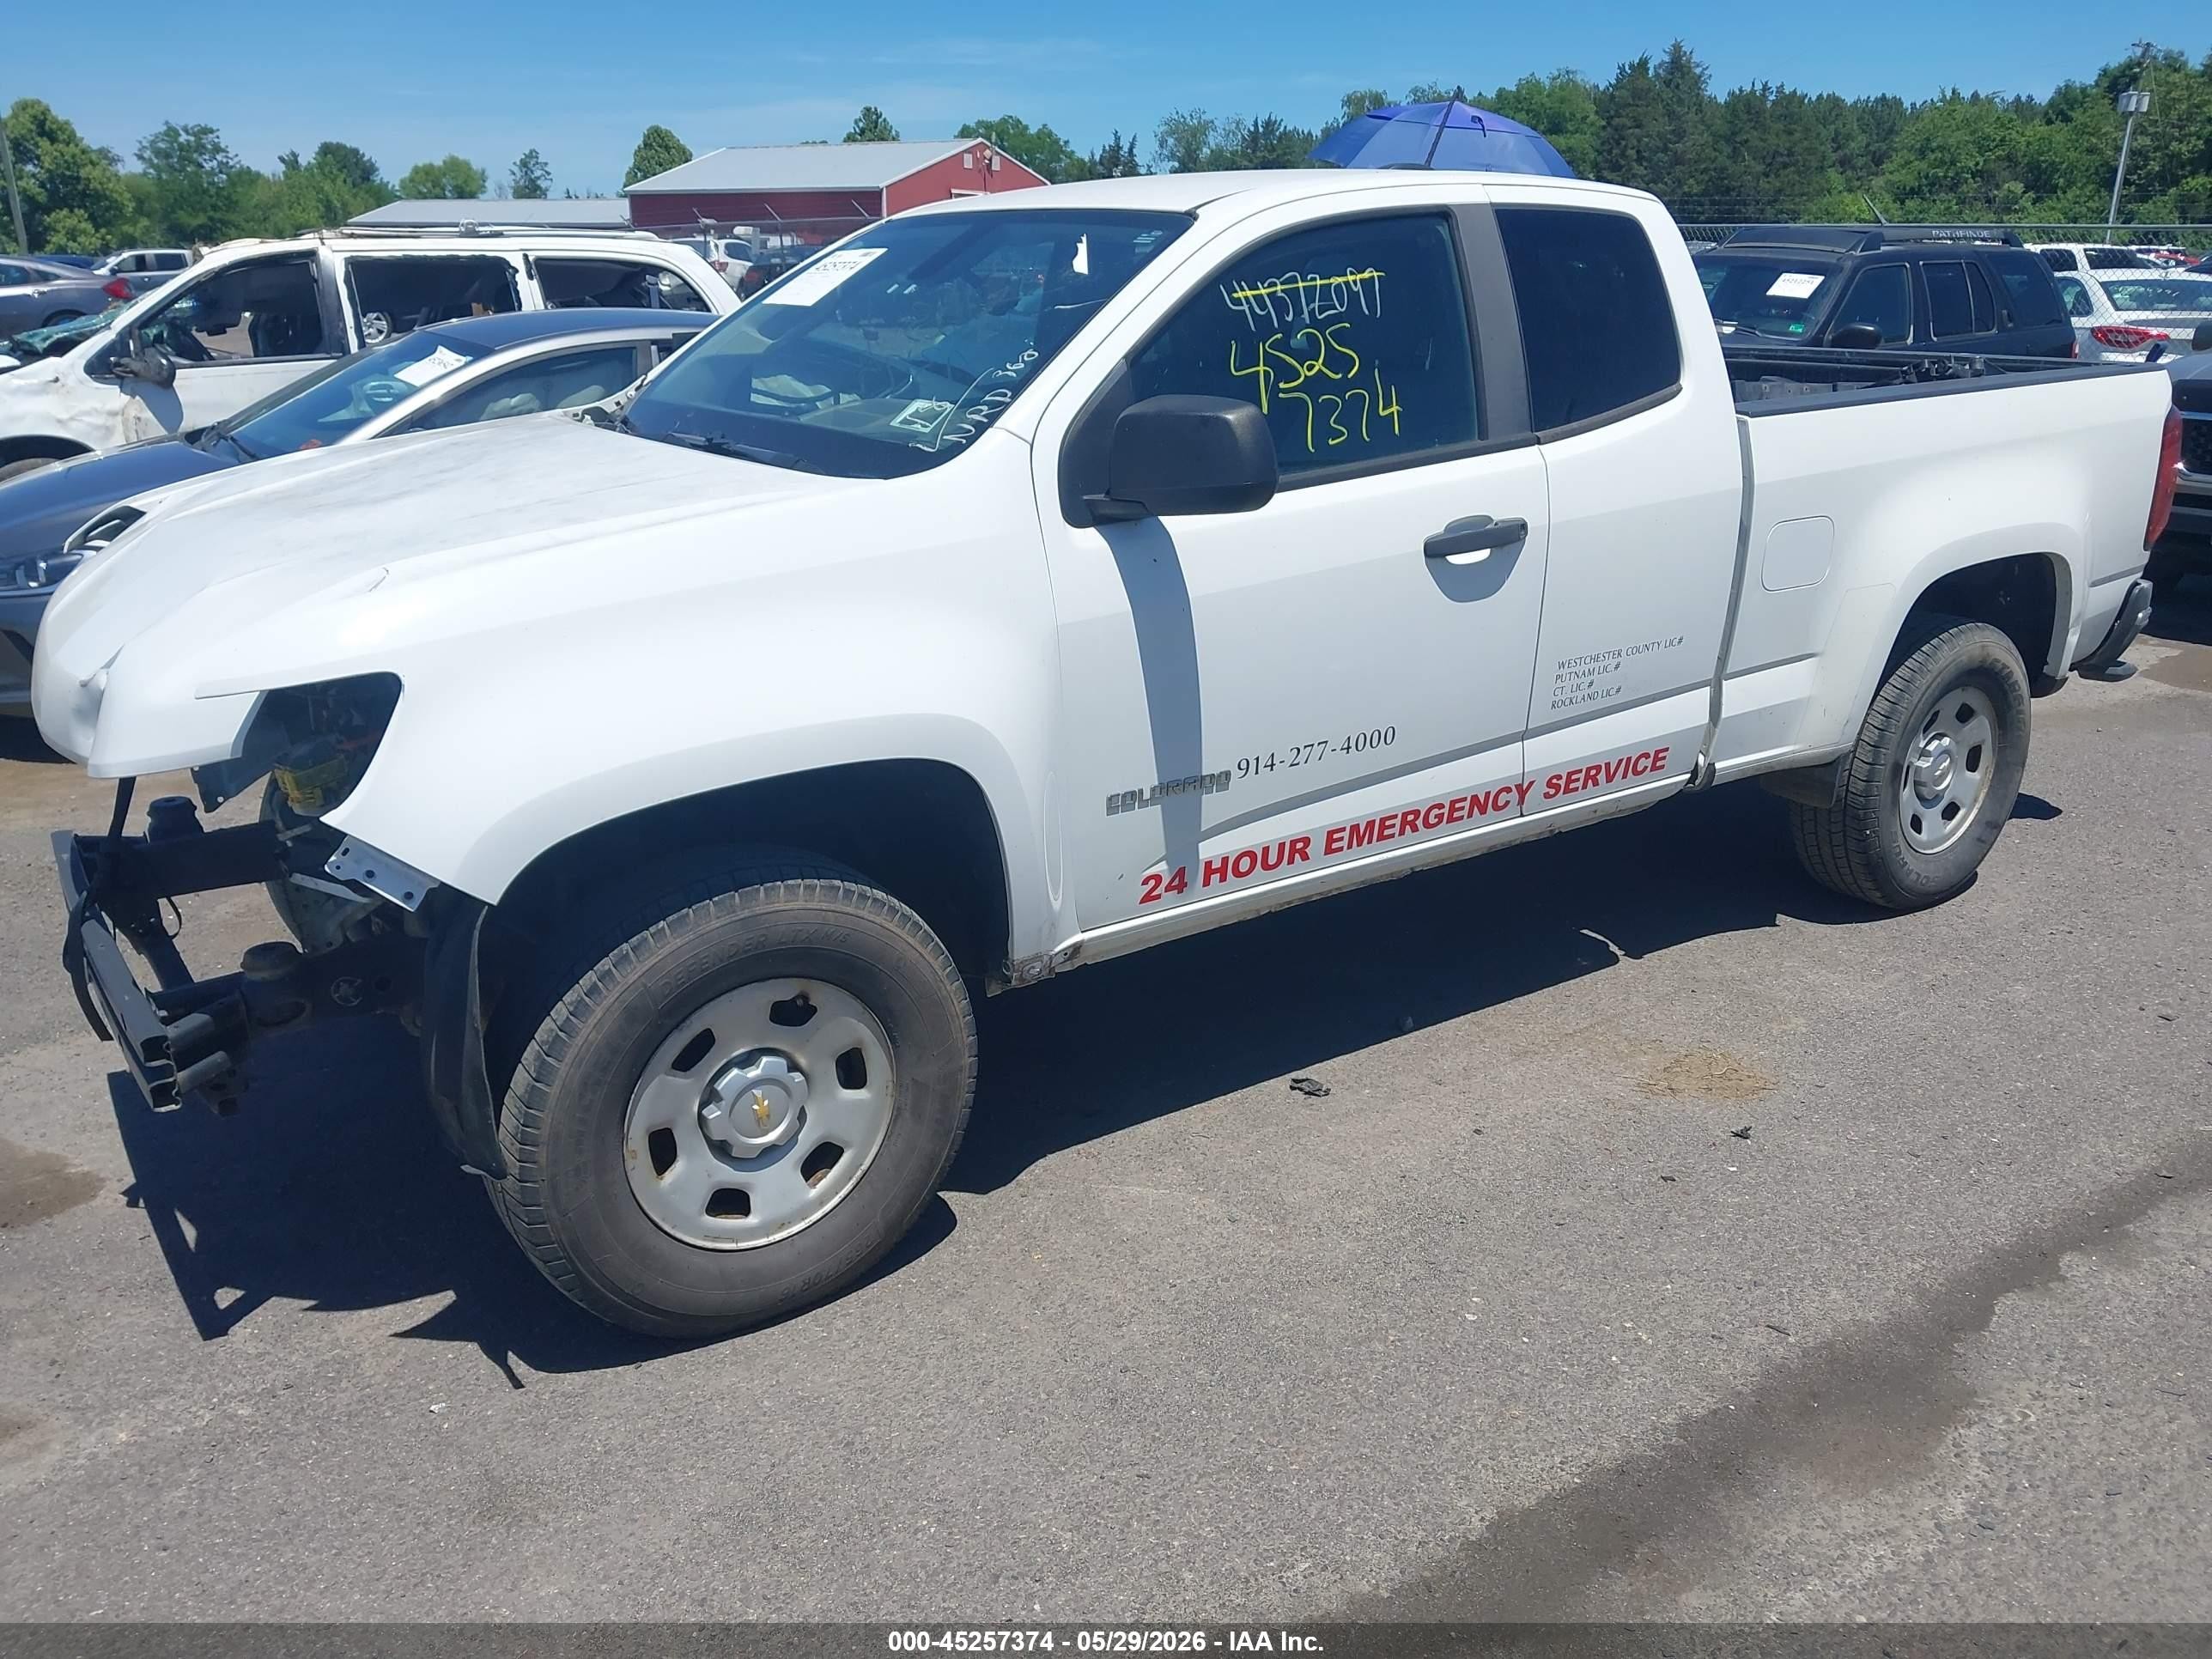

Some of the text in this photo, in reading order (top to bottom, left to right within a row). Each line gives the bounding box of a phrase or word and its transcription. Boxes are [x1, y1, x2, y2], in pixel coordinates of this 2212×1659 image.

[1231, 323, 1359, 415] 4525
[1279, 367, 1402, 453] 7374
[1554, 667, 1595, 684] PUTNAM
[1557, 648, 1623, 671] WESTCHESTER
[1626, 640, 1662, 658] COUNTY
[1551, 690, 1599, 710] ROCKLAND
[1553, 686, 1568, 697] CT.
[1237, 726, 1396, 780] 914-277-4000
[1105, 769, 1232, 817] COLORADO
[1139, 747, 1670, 905] 24 HOUR EMERGENCY SERVICE
